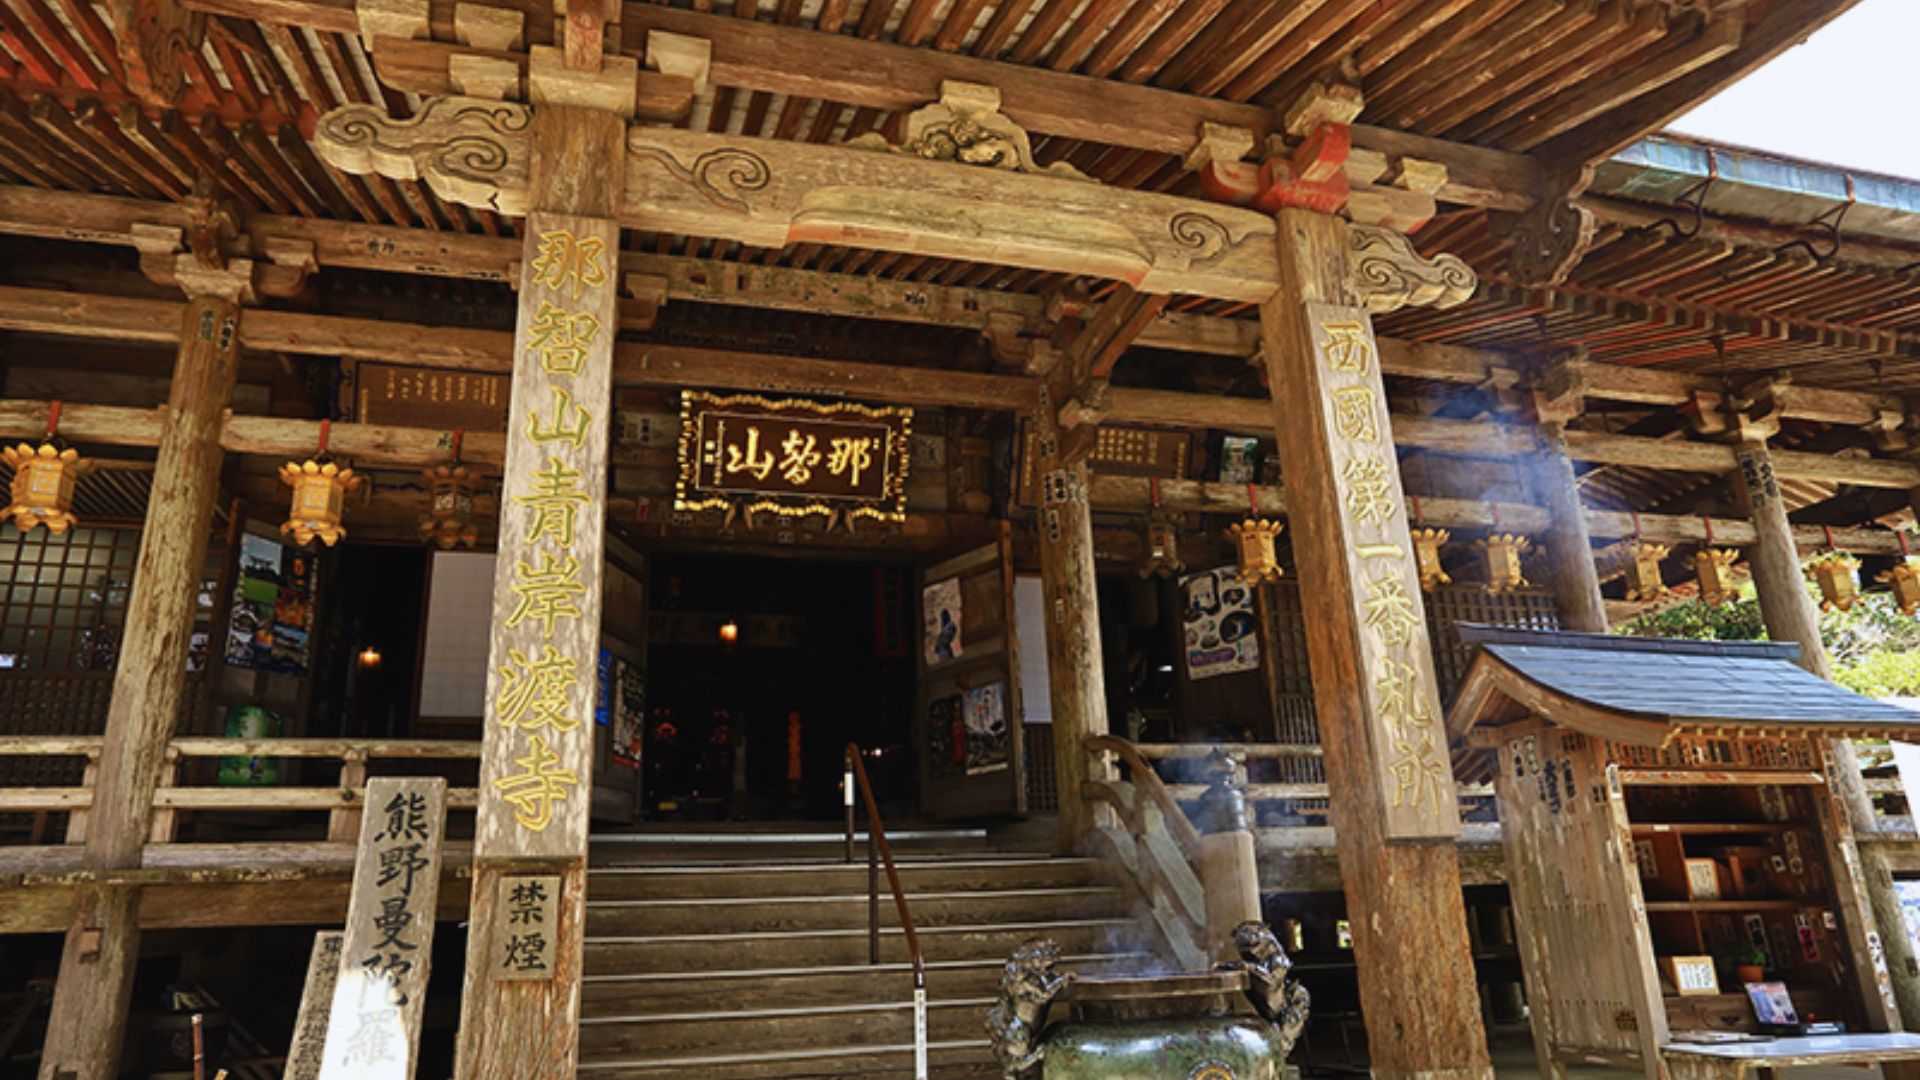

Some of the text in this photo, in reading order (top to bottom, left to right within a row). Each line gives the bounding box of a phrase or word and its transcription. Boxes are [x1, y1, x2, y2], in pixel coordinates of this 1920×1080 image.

[493, 229, 606, 832] 那智山青岸渡寺
[1319, 320, 1443, 817] 西國第一番札所
[502, 879, 550, 974] 禁煙
